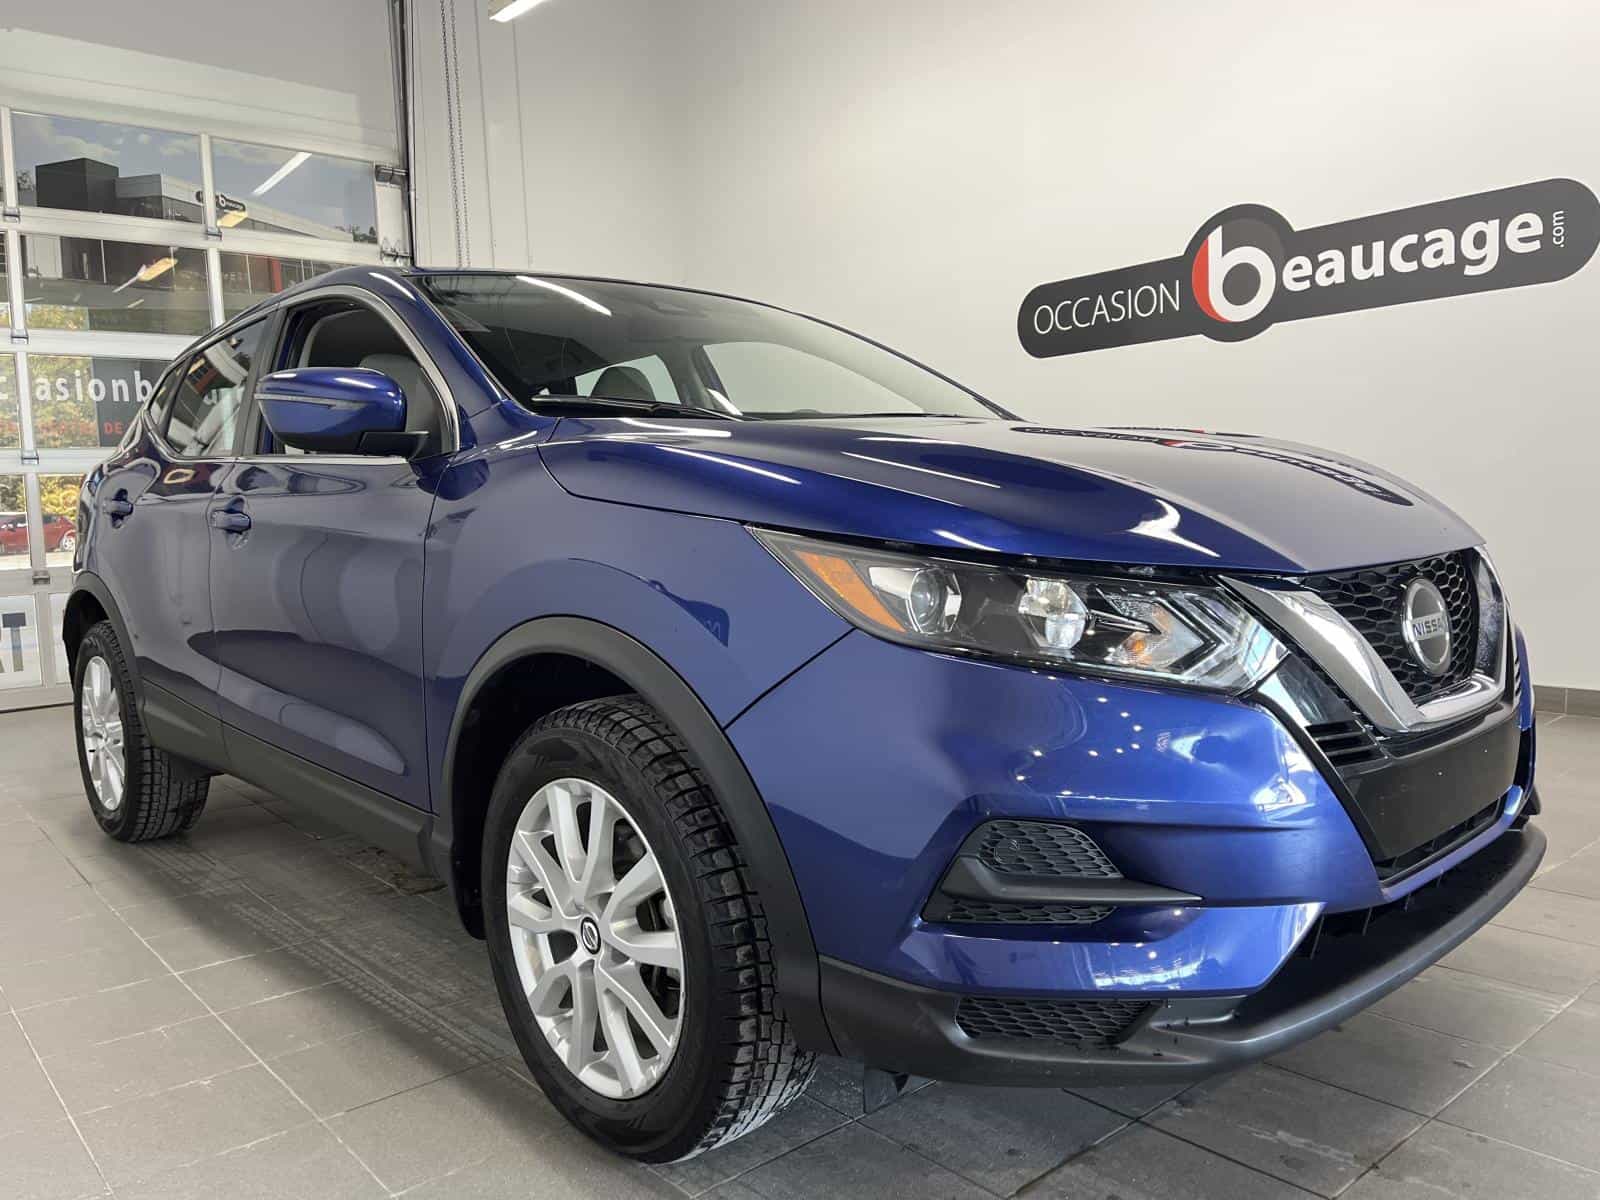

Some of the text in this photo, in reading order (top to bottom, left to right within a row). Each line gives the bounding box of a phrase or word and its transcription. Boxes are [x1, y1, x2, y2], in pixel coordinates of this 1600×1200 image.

[1034, 210, 1565, 334] OCCASION beaucage .com
